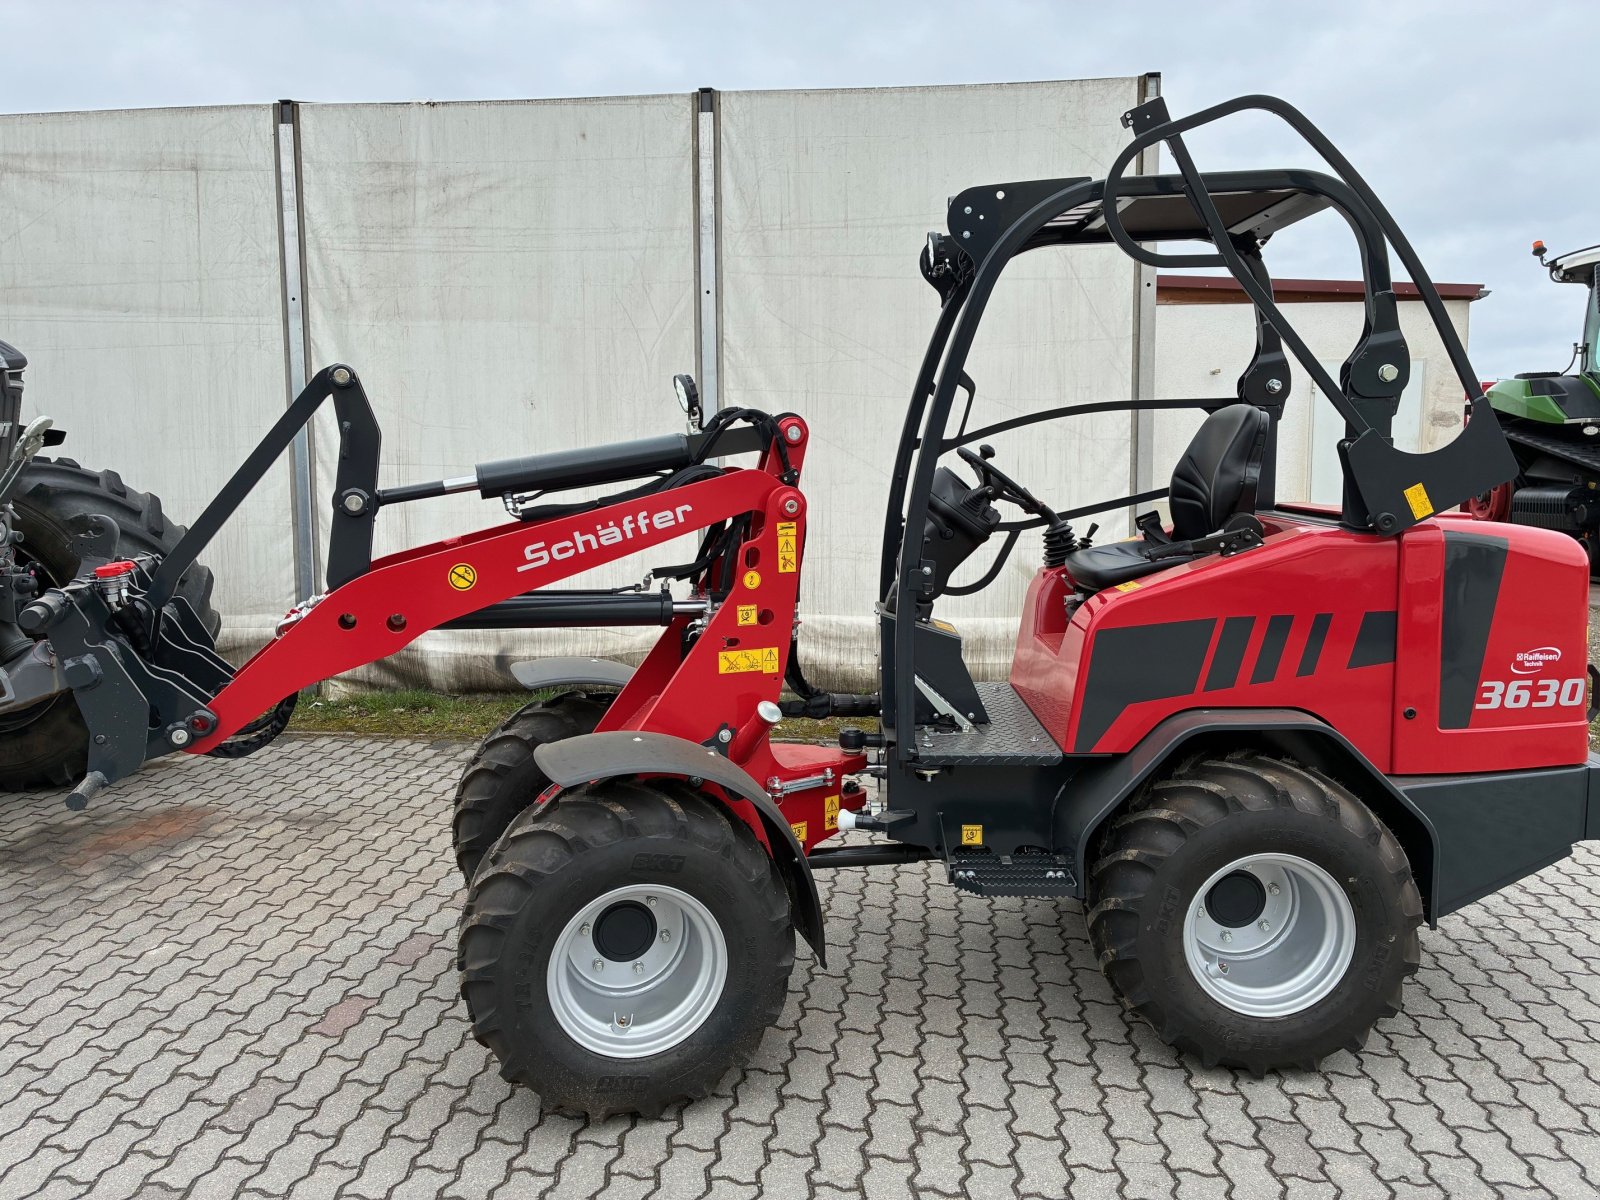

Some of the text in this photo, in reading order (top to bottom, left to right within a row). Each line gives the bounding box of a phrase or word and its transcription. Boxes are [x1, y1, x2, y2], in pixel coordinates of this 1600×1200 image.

[516, 504, 693, 573] Schäffer
[1524, 652, 1558, 661] Raiffeisen
[1475, 678, 1585, 709] 3630
